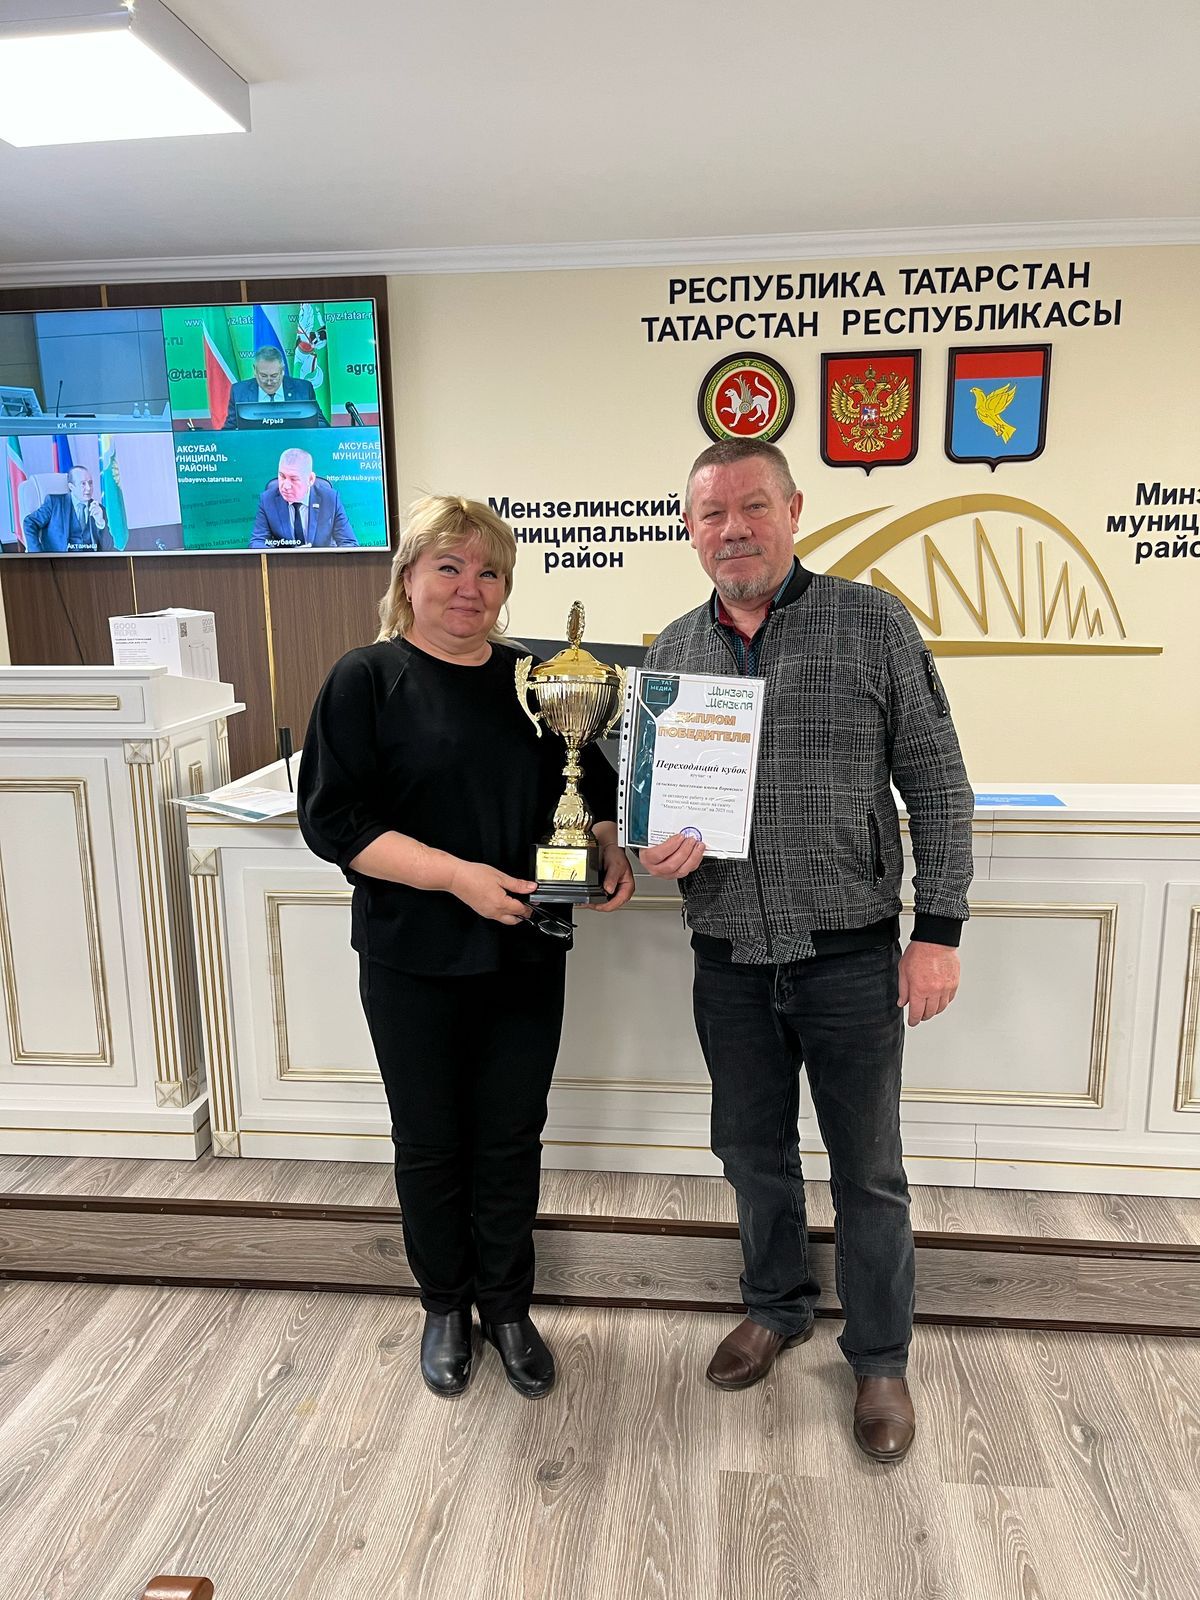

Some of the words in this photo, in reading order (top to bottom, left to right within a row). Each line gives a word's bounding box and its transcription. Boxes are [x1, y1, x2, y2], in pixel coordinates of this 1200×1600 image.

[669, 271, 885, 304] РЕСПУБЛИКА
[899, 261, 1090, 295] ТАТАРСТАН
[641, 311, 818, 342] ТАТАРСТАН
[843, 299, 1122, 335] РЕСПУБЛИКАСЫ
[262, 417, 284, 425] Агрыз
[176, 443, 217, 453] АКСУБАЙ
[179, 463, 217, 472] РАЙОНЫ
[488, 493, 681, 519] Мензелинский
[1106, 514, 1200, 538] муниц
[545, 546, 624, 573] район
[658, 726, 751, 743] ПОБЕДИТЕЛЯ
[656, 760, 719, 773] Переходящий
[721, 765, 747, 775] кубок
